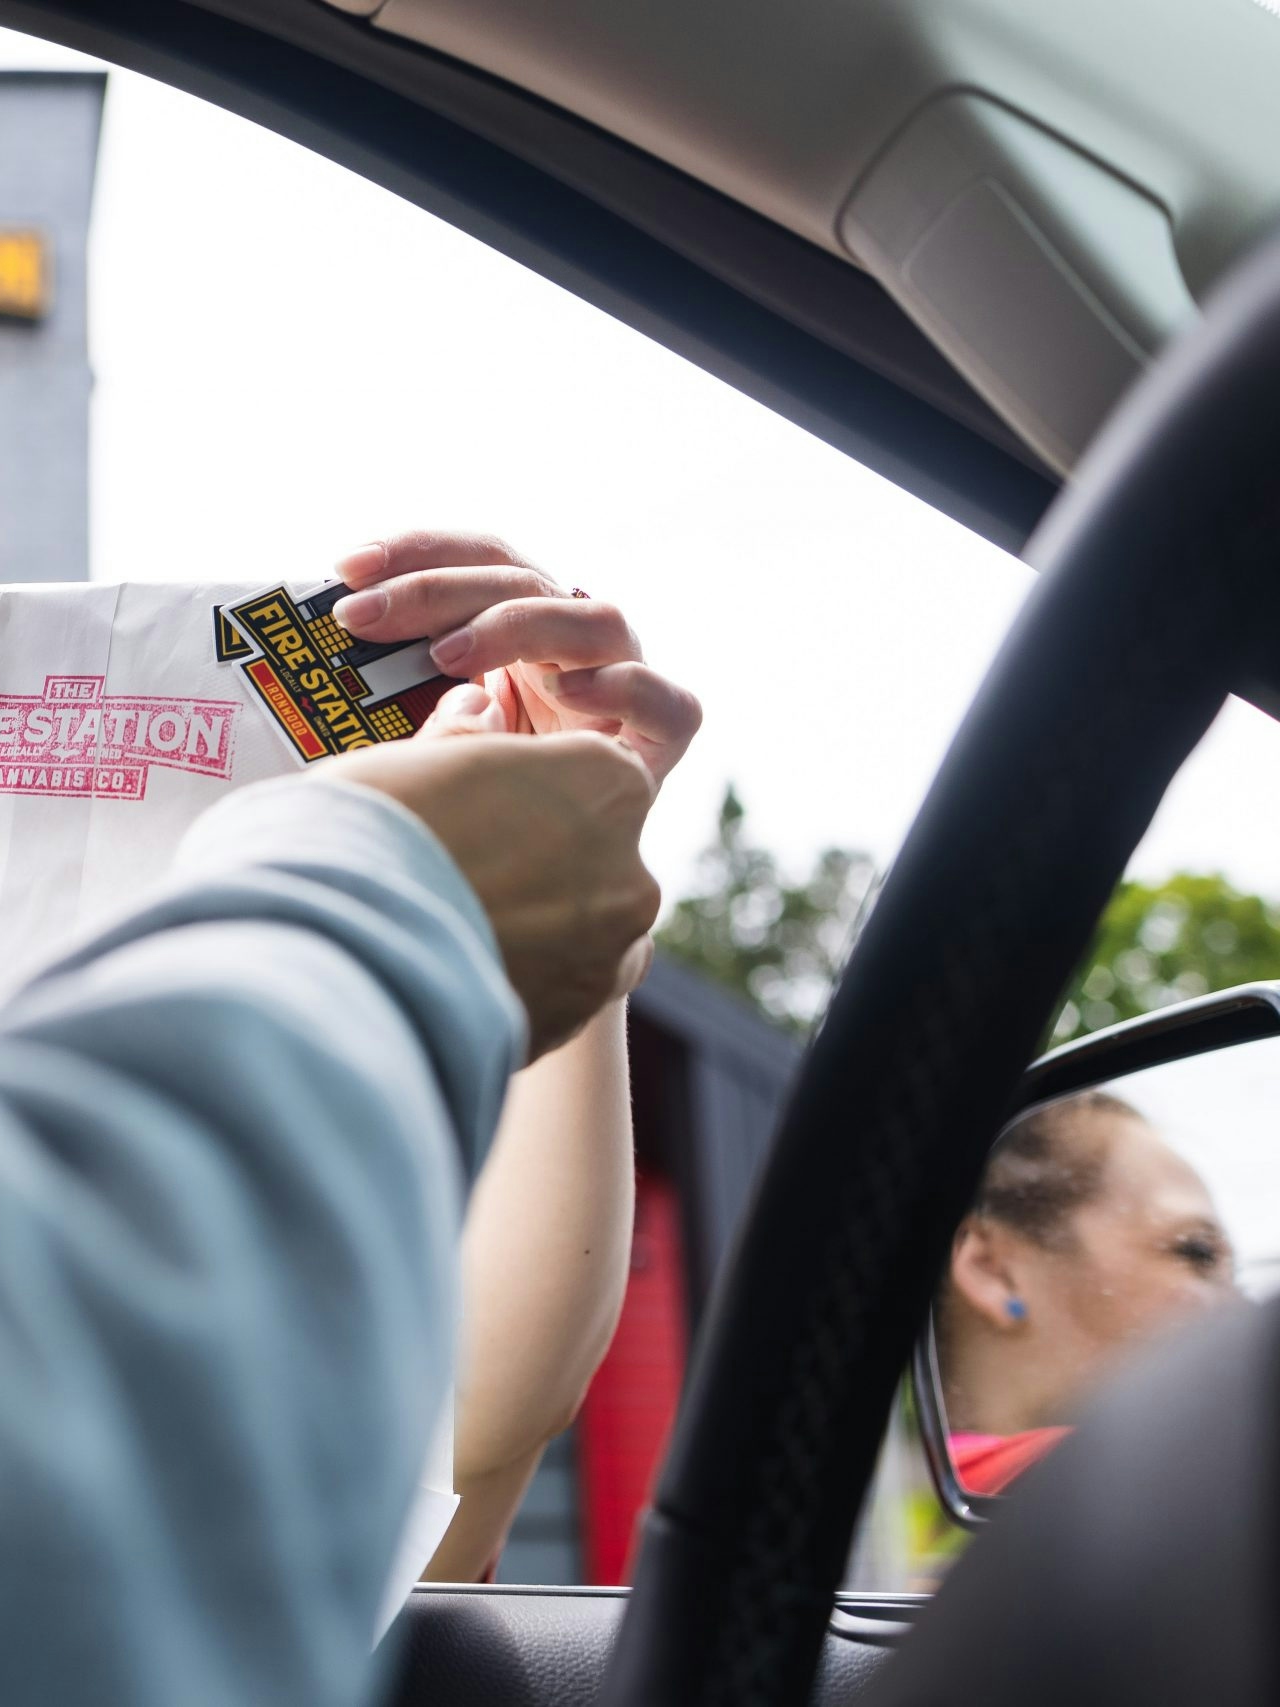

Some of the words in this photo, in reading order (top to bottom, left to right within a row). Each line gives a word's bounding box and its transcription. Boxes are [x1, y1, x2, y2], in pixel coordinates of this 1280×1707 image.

[248, 601, 317, 671] FIRE
[52, 683, 94, 698] THE
[280, 667, 302, 693] LOCALLY
[264, 682, 308, 736] IRONWOOD
[23, 708, 227, 759] STATION
[97, 771, 132, 790] CO.
